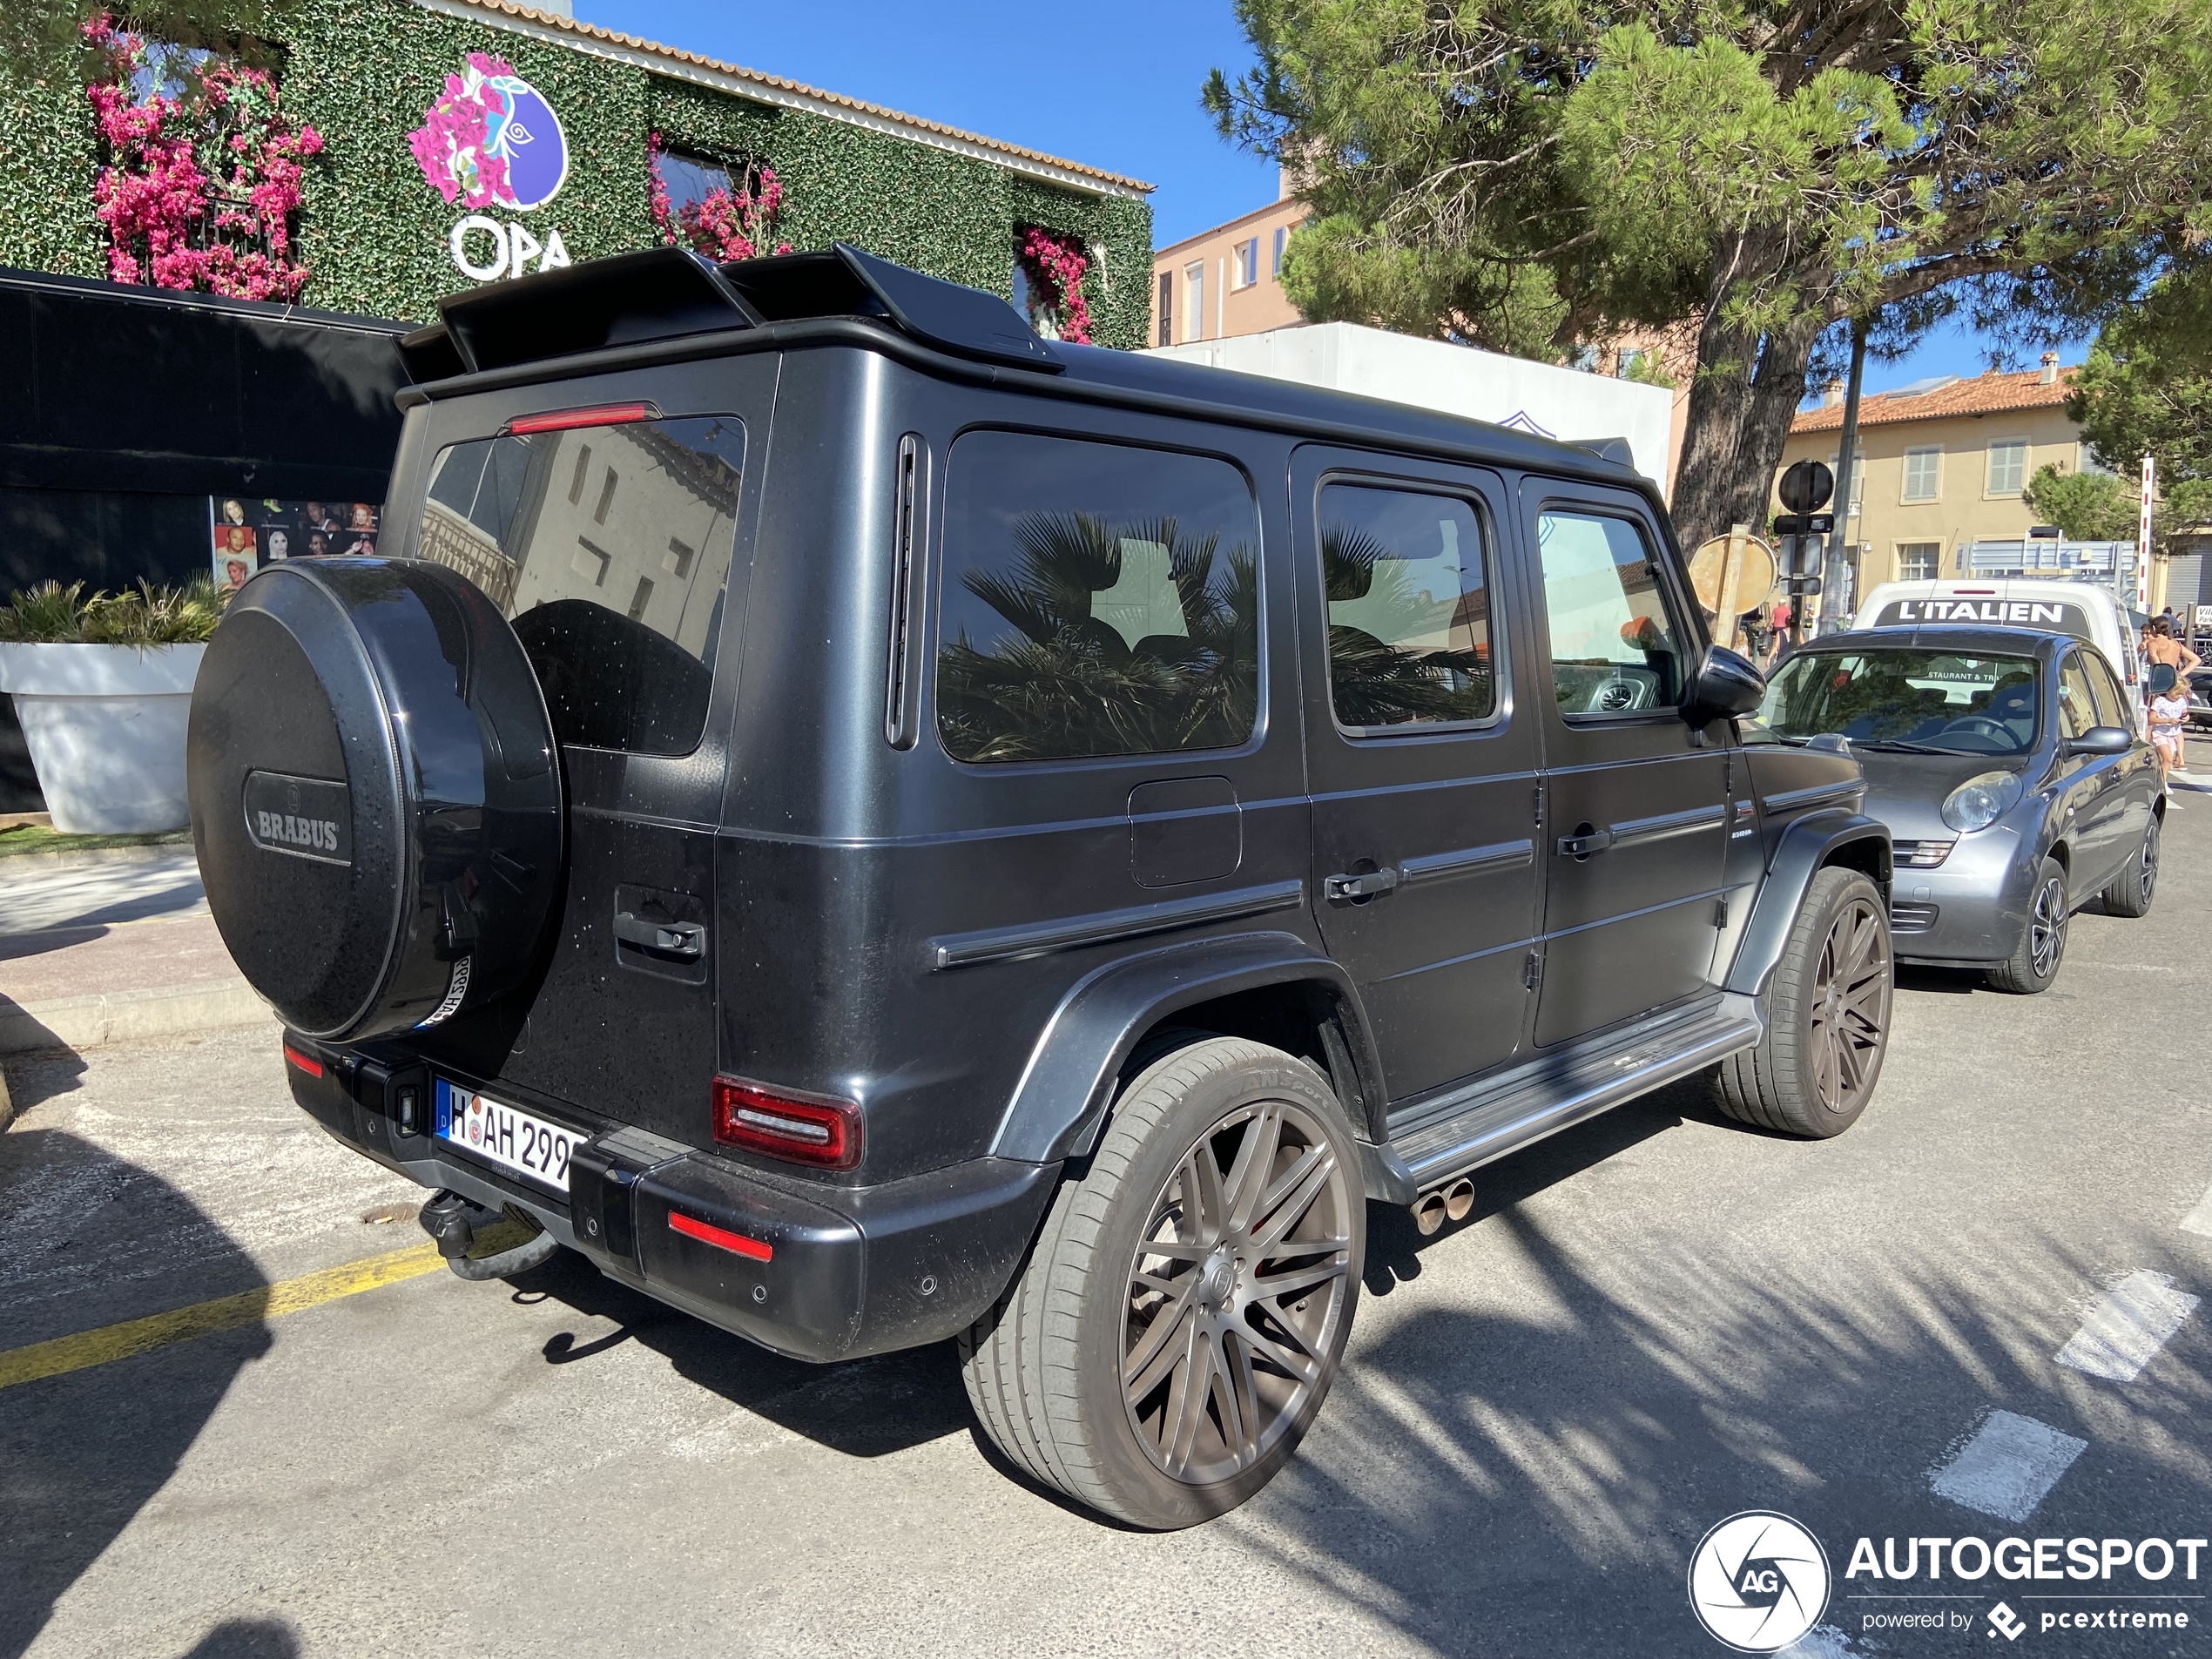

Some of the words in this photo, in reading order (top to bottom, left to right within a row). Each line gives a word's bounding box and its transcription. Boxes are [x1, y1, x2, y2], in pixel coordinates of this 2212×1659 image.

[450, 215, 571, 280] OPA
[1898, 601, 2063, 623] L'ITALIEN
[1925, 671, 1972, 680] STAURANT
[258, 810, 338, 851] BRABUS
[441, 1115, 447, 1127] D
[451, 1091, 466, 1140] H
[483, 1106, 515, 1160] AH
[523, 1120, 582, 1181] 299
